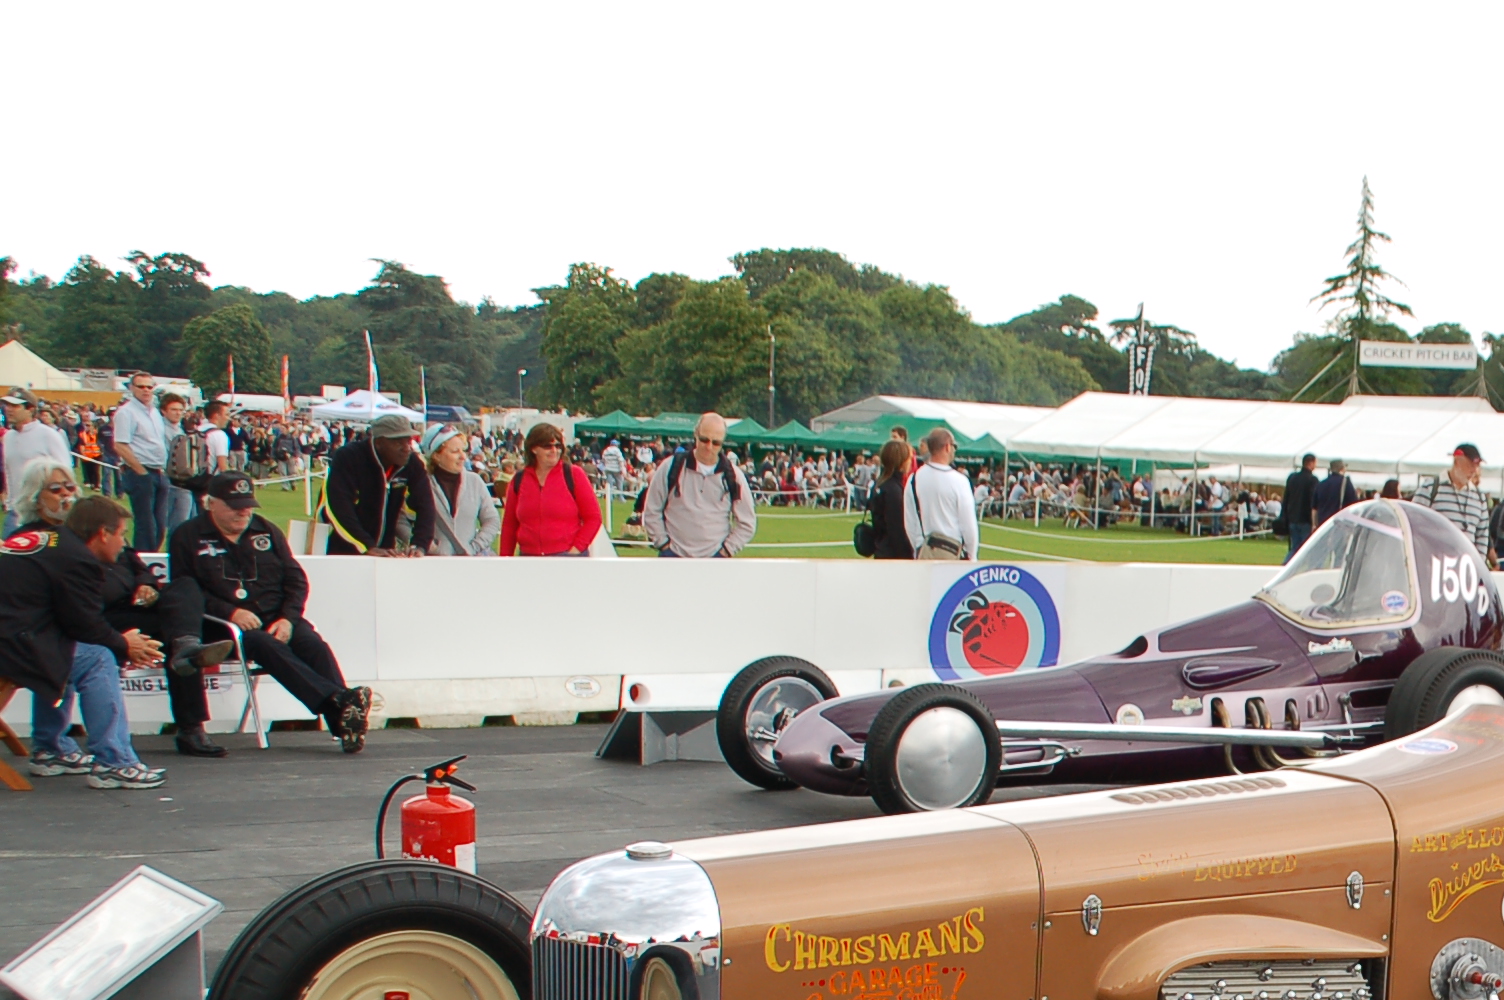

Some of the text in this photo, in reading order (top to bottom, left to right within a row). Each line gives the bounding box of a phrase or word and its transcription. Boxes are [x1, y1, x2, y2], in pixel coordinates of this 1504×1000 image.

[1363, 347, 1474, 361] CRICKET PITCH BAR
[1135, 345, 1147, 396] FO
[968, 566, 1021, 587] YENKO
[1430, 553, 1478, 603] 150
[1410, 832, 1452, 853] ART
[1193, 854, 1297, 882] EQUIPPED
[765, 906, 985, 973] CHRISMANS
[828, 962, 939, 994] GARAGE
